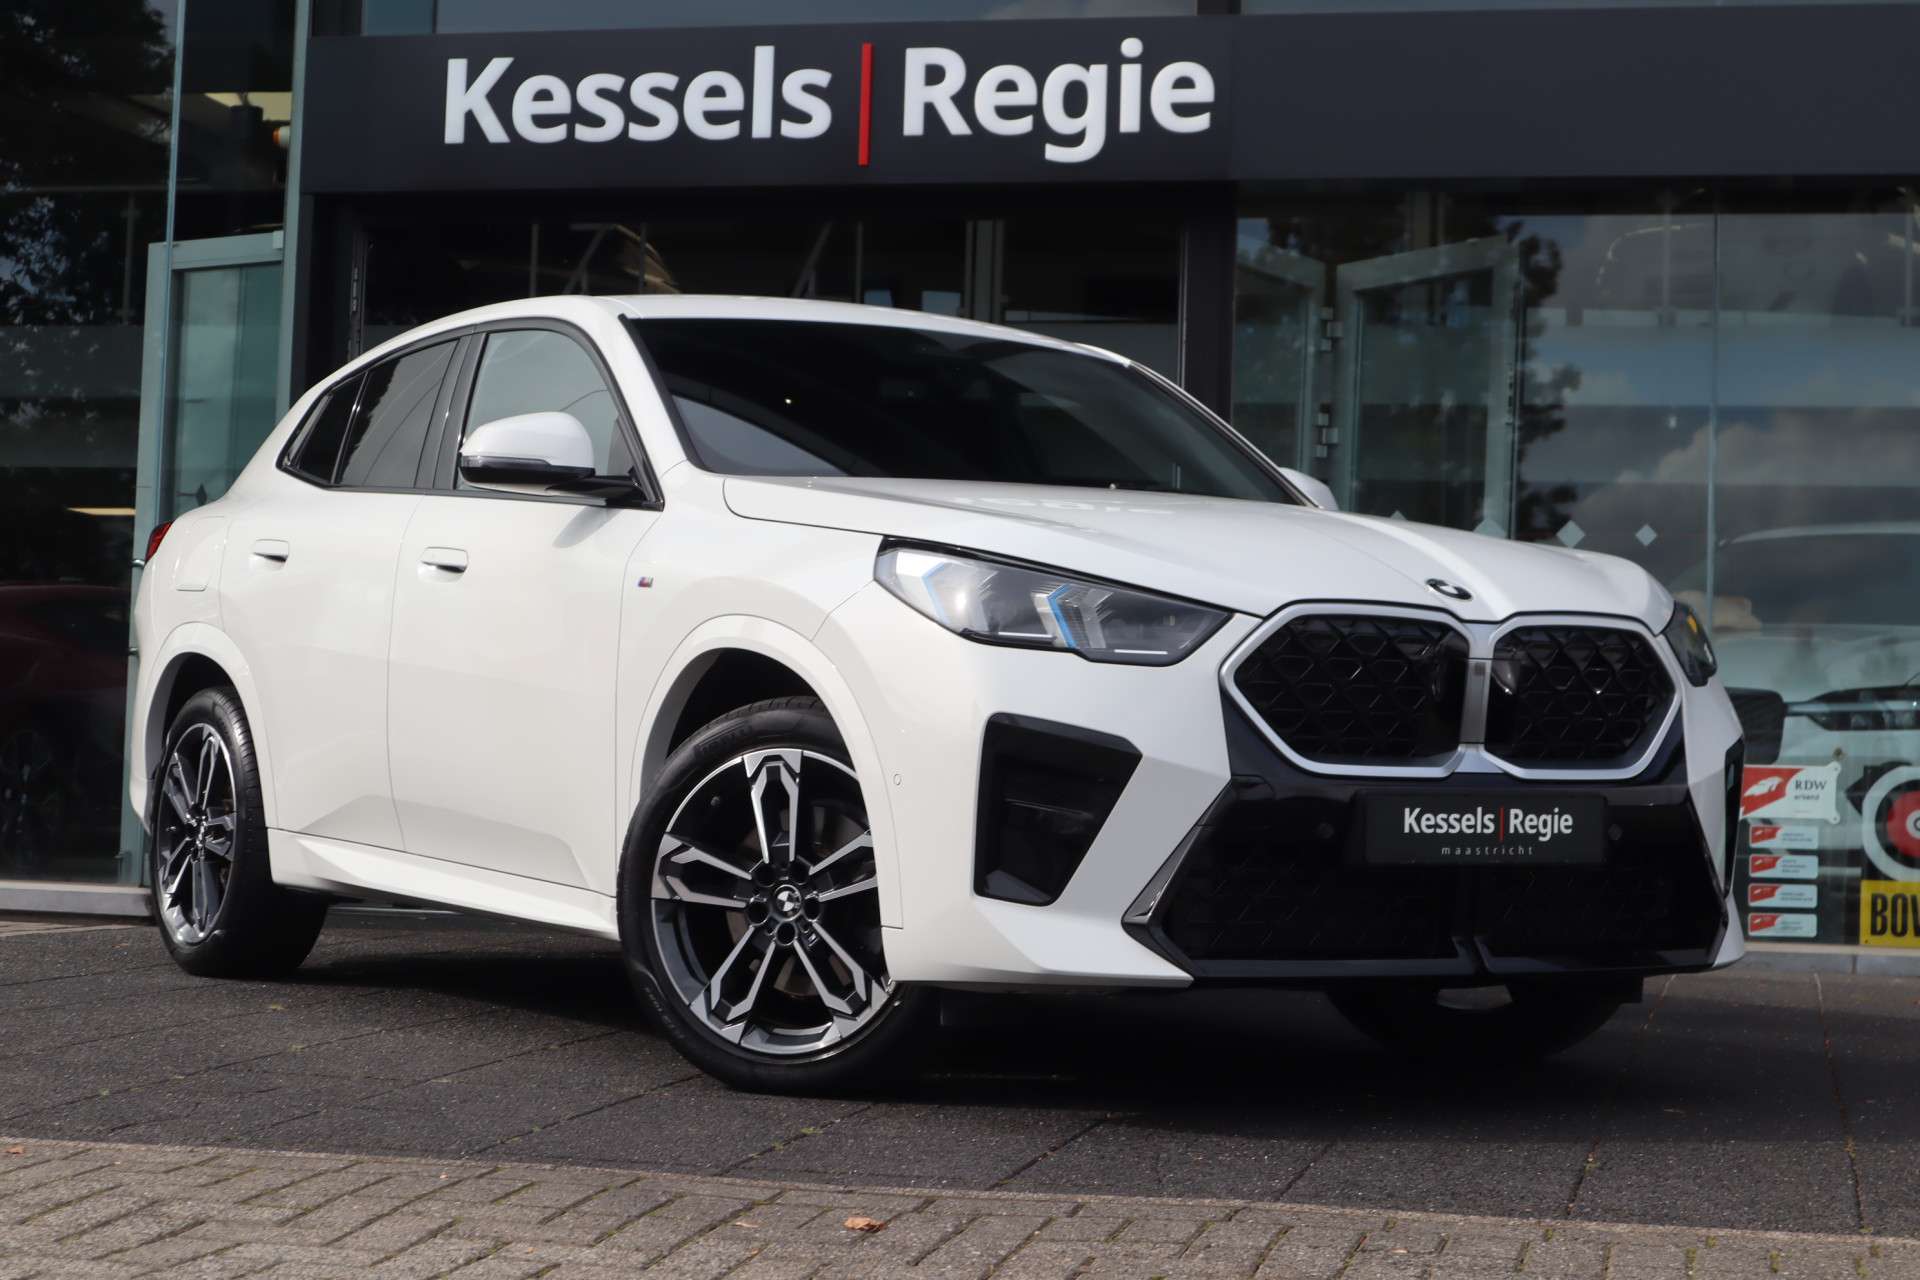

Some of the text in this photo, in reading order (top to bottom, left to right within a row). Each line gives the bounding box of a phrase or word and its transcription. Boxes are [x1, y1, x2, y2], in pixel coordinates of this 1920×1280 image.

[444, 37, 1215, 163] Kessels Regie
[1795, 779, 1828, 791] RDW
[1402, 806, 1574, 842] Kessels Regie
[1441, 845, 1534, 856] maastricht
